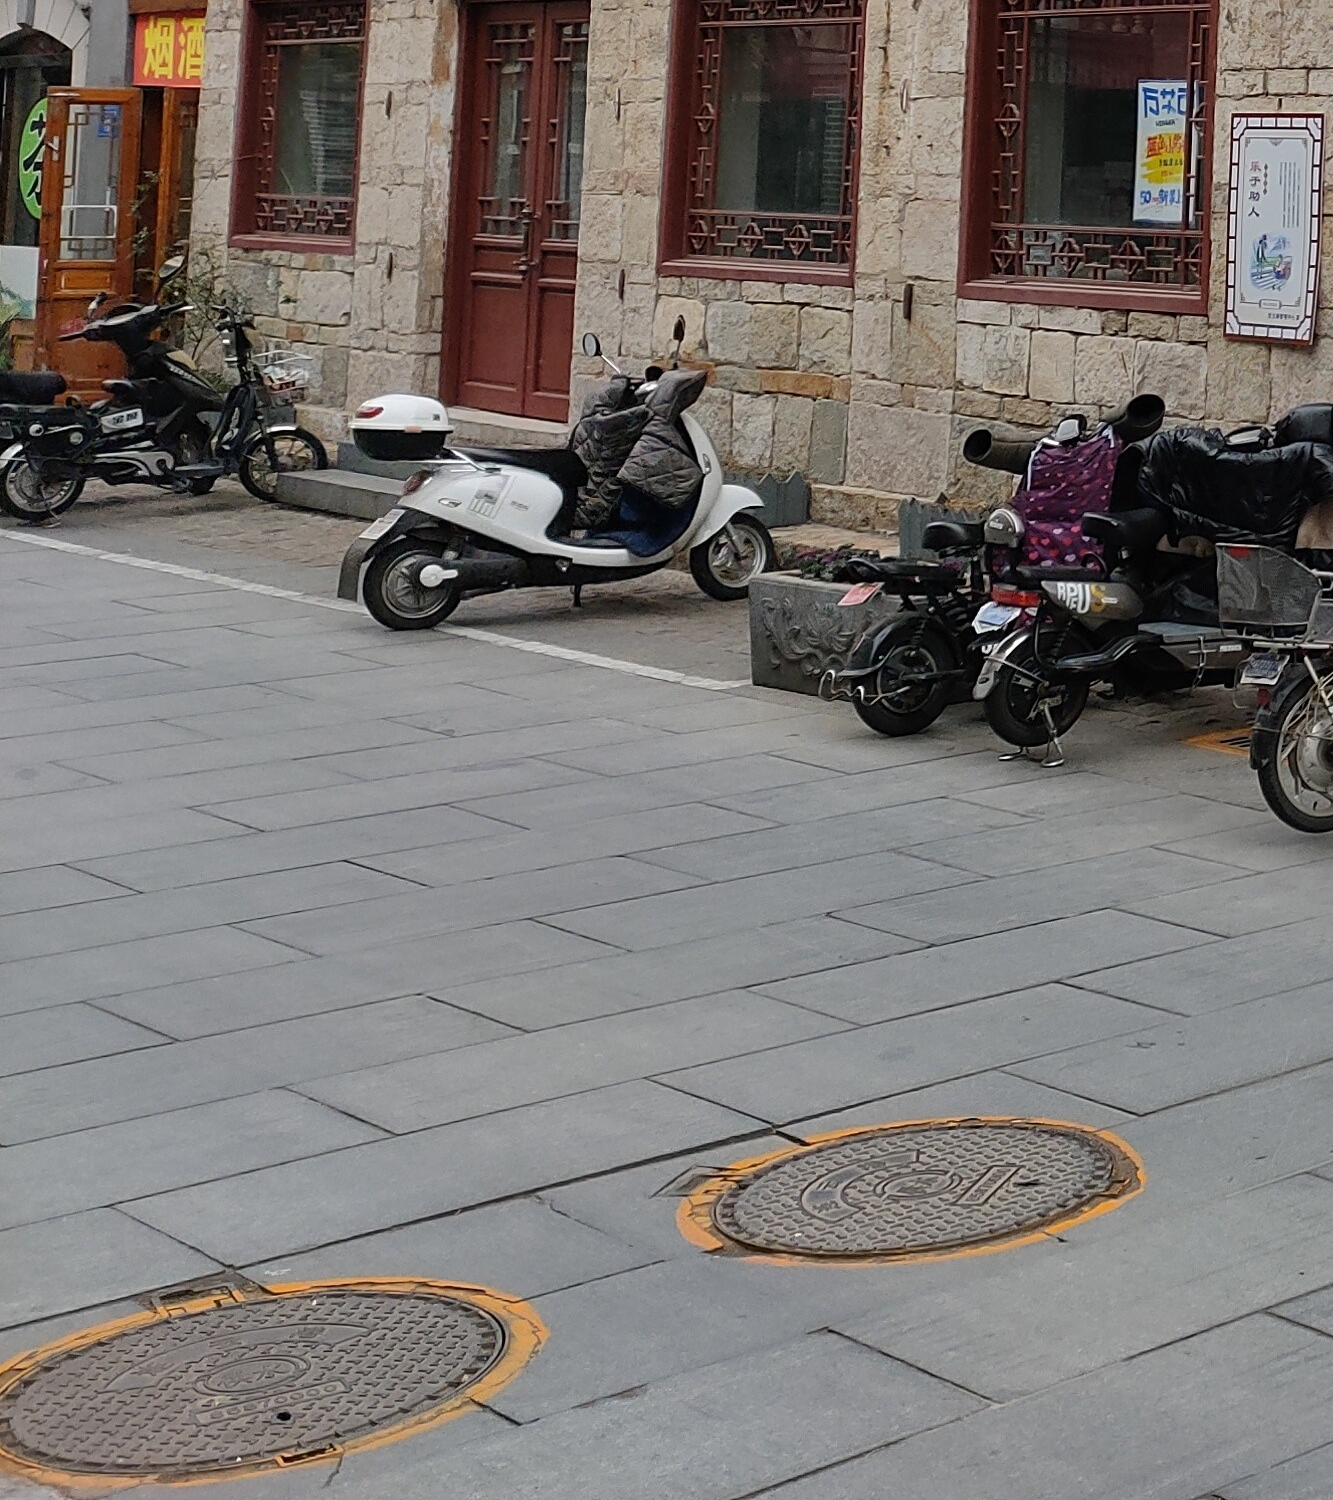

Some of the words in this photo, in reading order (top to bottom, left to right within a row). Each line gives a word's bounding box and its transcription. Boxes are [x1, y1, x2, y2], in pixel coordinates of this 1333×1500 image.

[143, 16, 205, 79] 烟酒
[1248, 161, 1262, 218] 乐于助人
